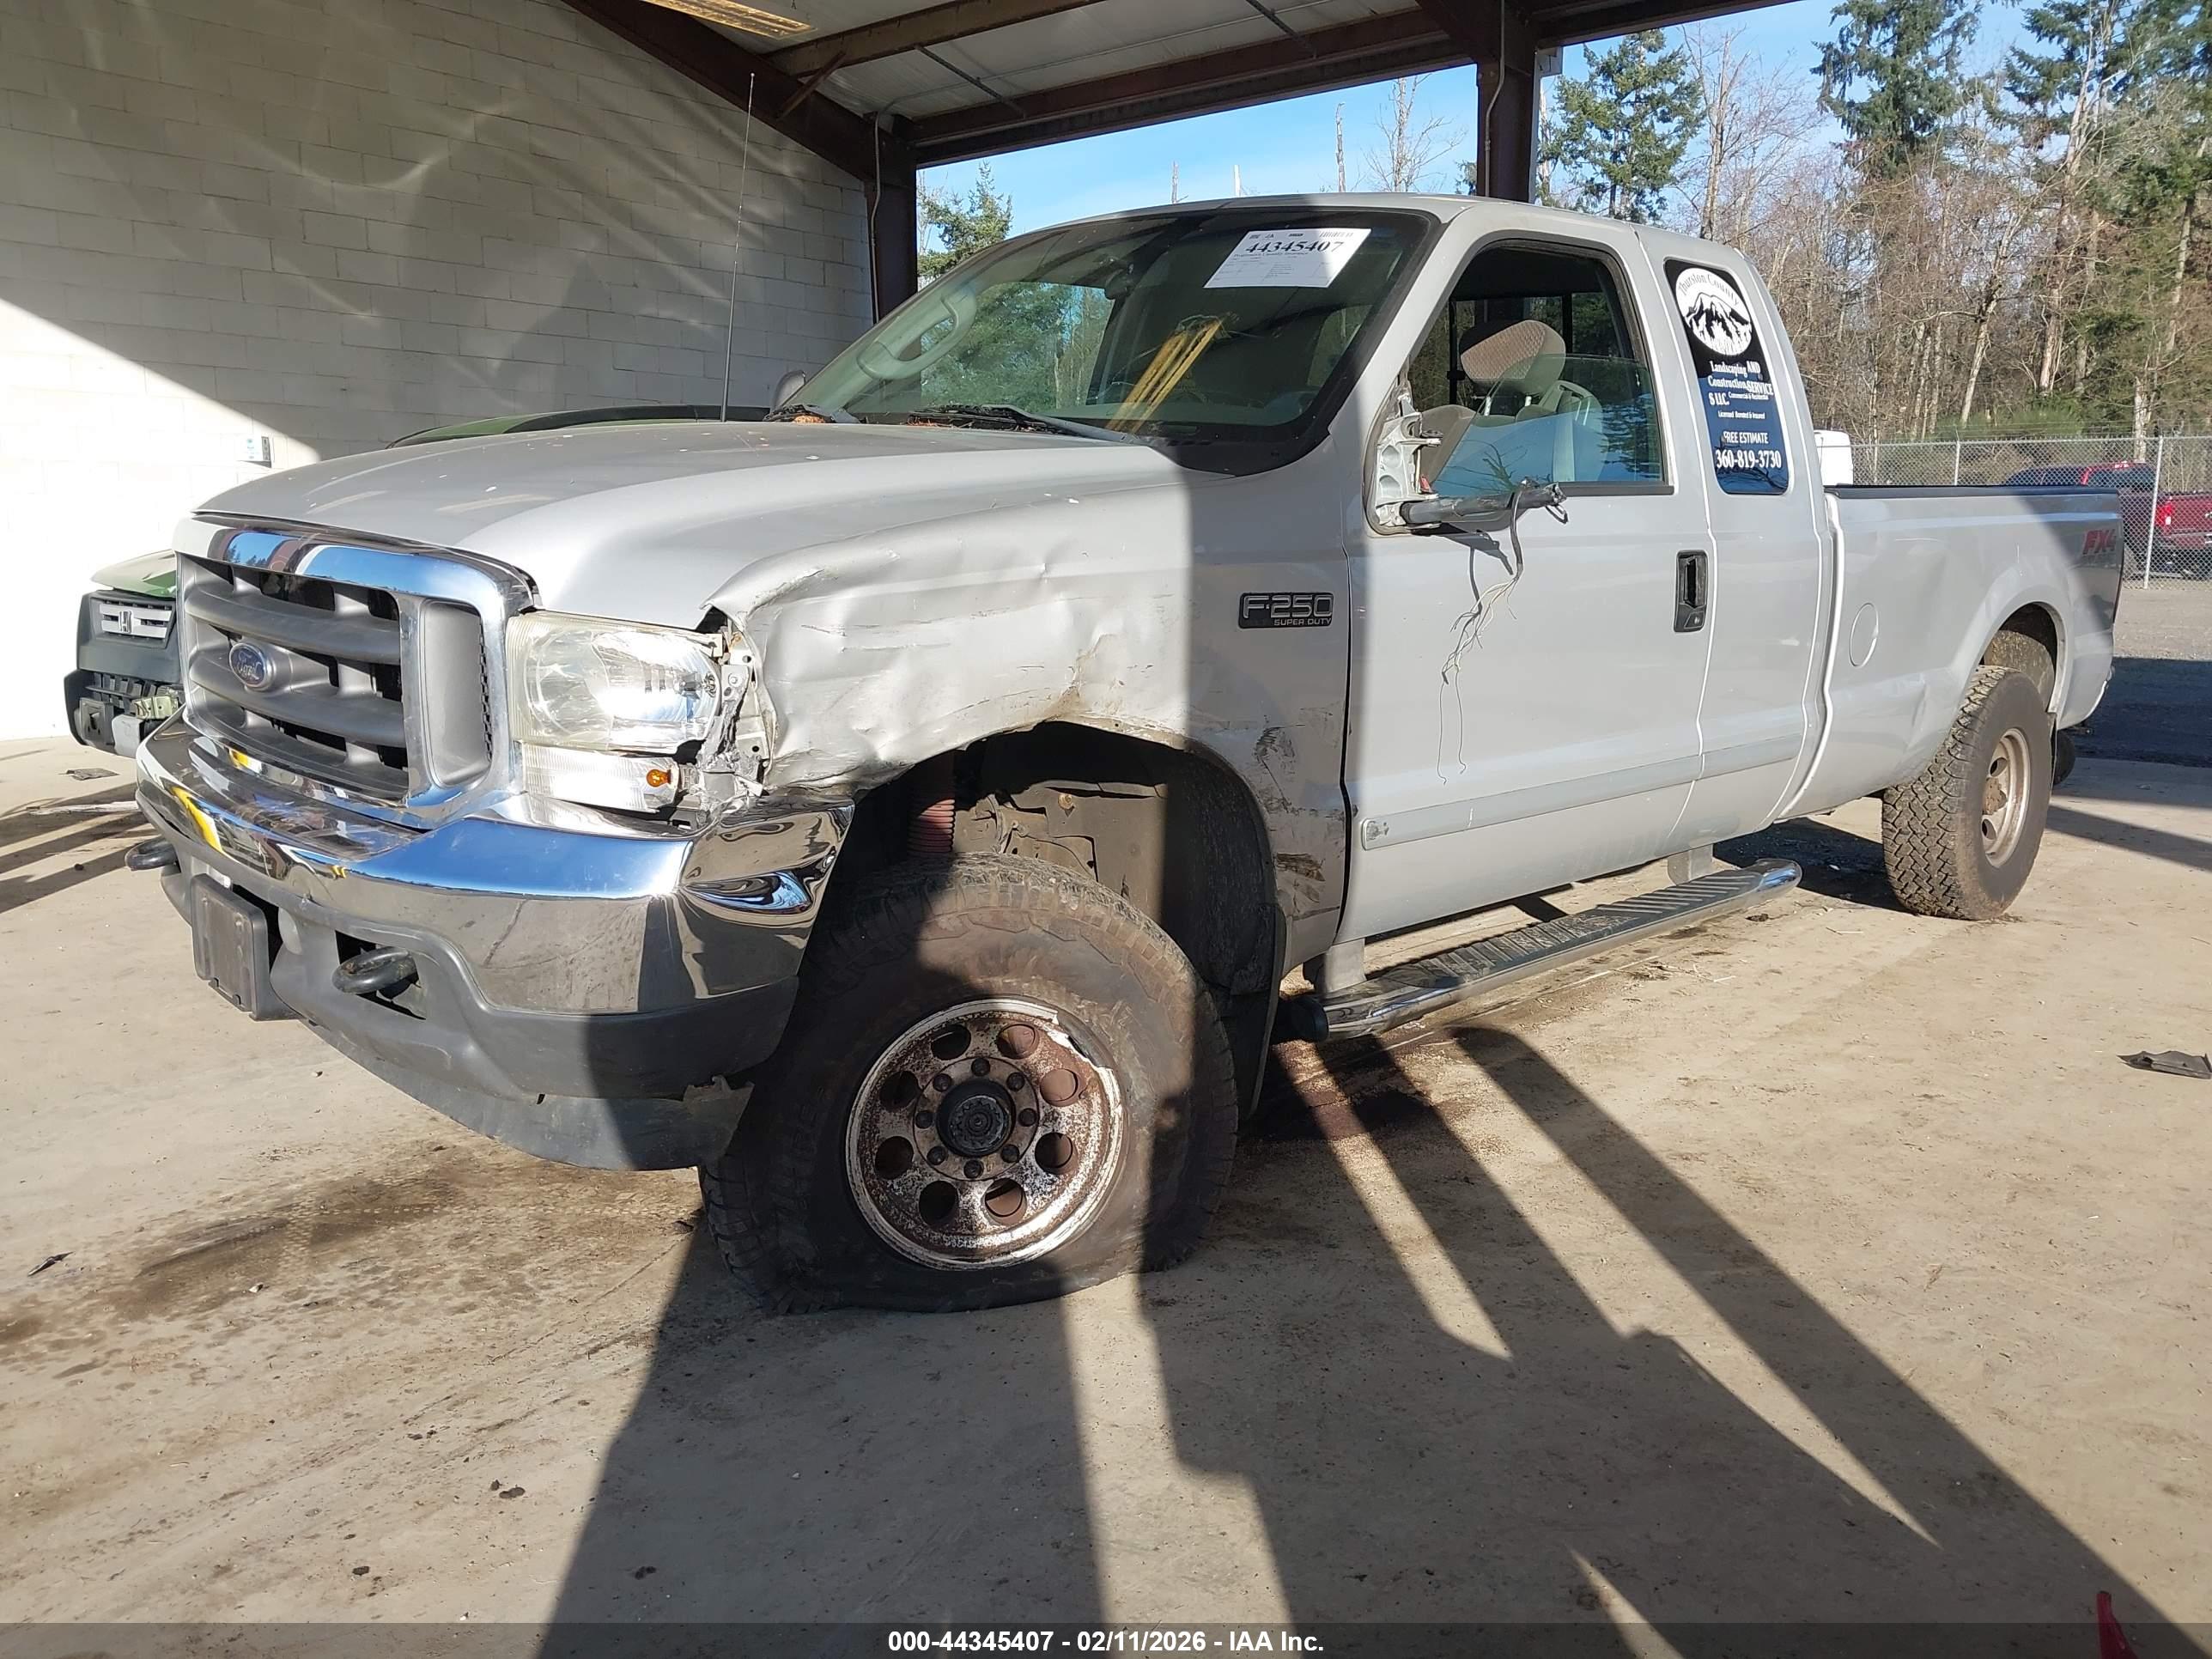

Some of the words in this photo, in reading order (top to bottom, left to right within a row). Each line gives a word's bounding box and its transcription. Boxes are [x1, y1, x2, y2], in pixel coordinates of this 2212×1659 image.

[1245, 240, 1345, 252] 44345407
[1678, 273, 1707, 296] Thurston
[1707, 274, 1740, 306] County
[1710, 361, 1748, 378] Landscaping
[1747, 360, 1761, 374] AND
[1708, 375, 1747, 389] Construction
[1745, 380, 1774, 397] SERVICE
[1723, 431, 1738, 443] FREE
[1739, 431, 1769, 444] ESTIMATE
[1716, 450, 1782, 468] 360-819-3730
[1273, 617, 1304, 626] SUPER
[1307, 617, 1332, 625] DUTY
